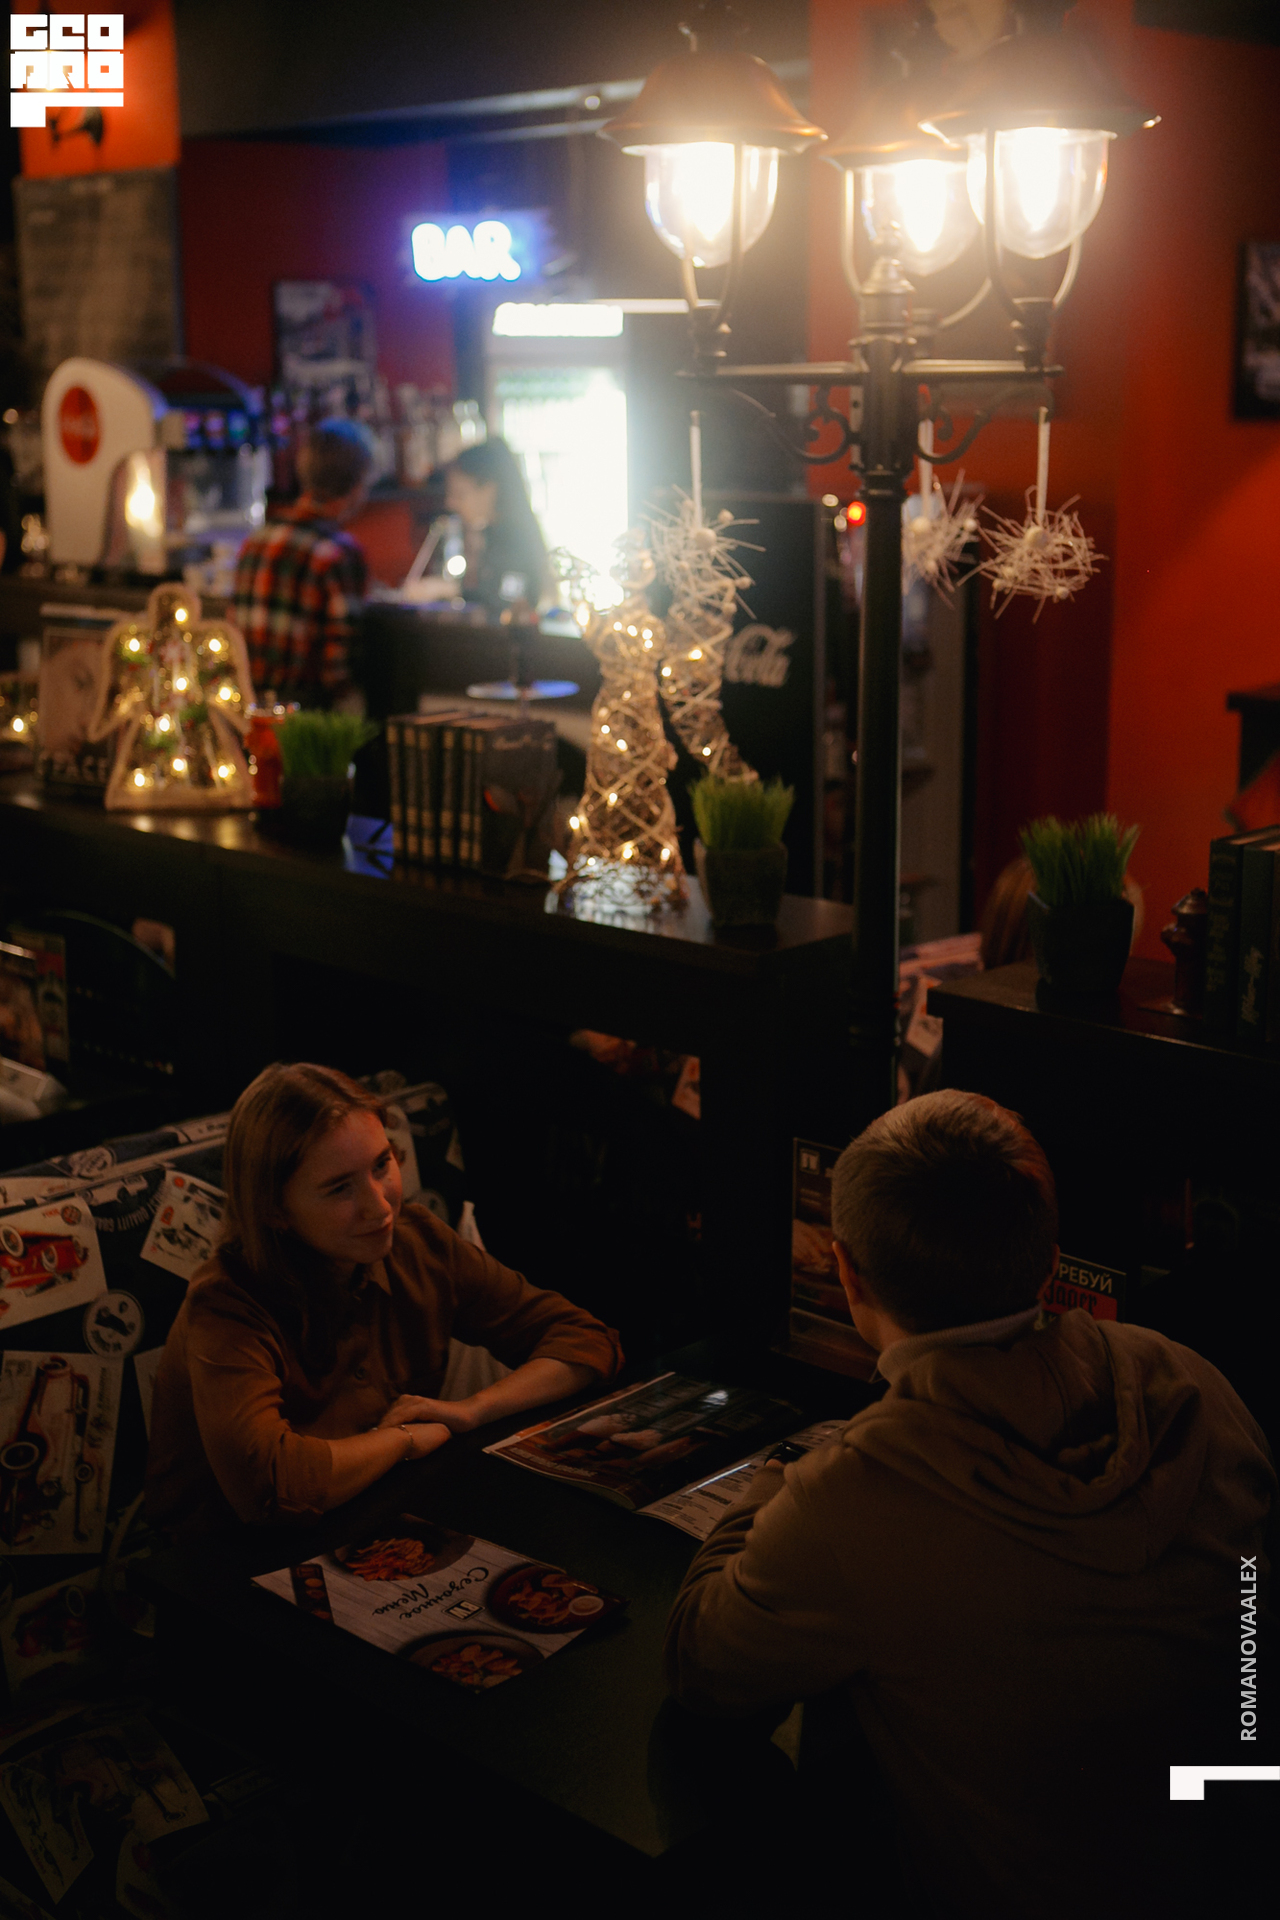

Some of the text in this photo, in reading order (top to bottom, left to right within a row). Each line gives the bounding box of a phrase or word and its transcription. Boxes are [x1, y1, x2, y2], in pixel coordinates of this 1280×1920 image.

[411, 219, 522, 282] BAR
[1058, 1262, 1114, 1295] РЕБУЙ
[371, 1582, 430, 1618] Меню
[398, 1566, 490, 1621] Сезонное
